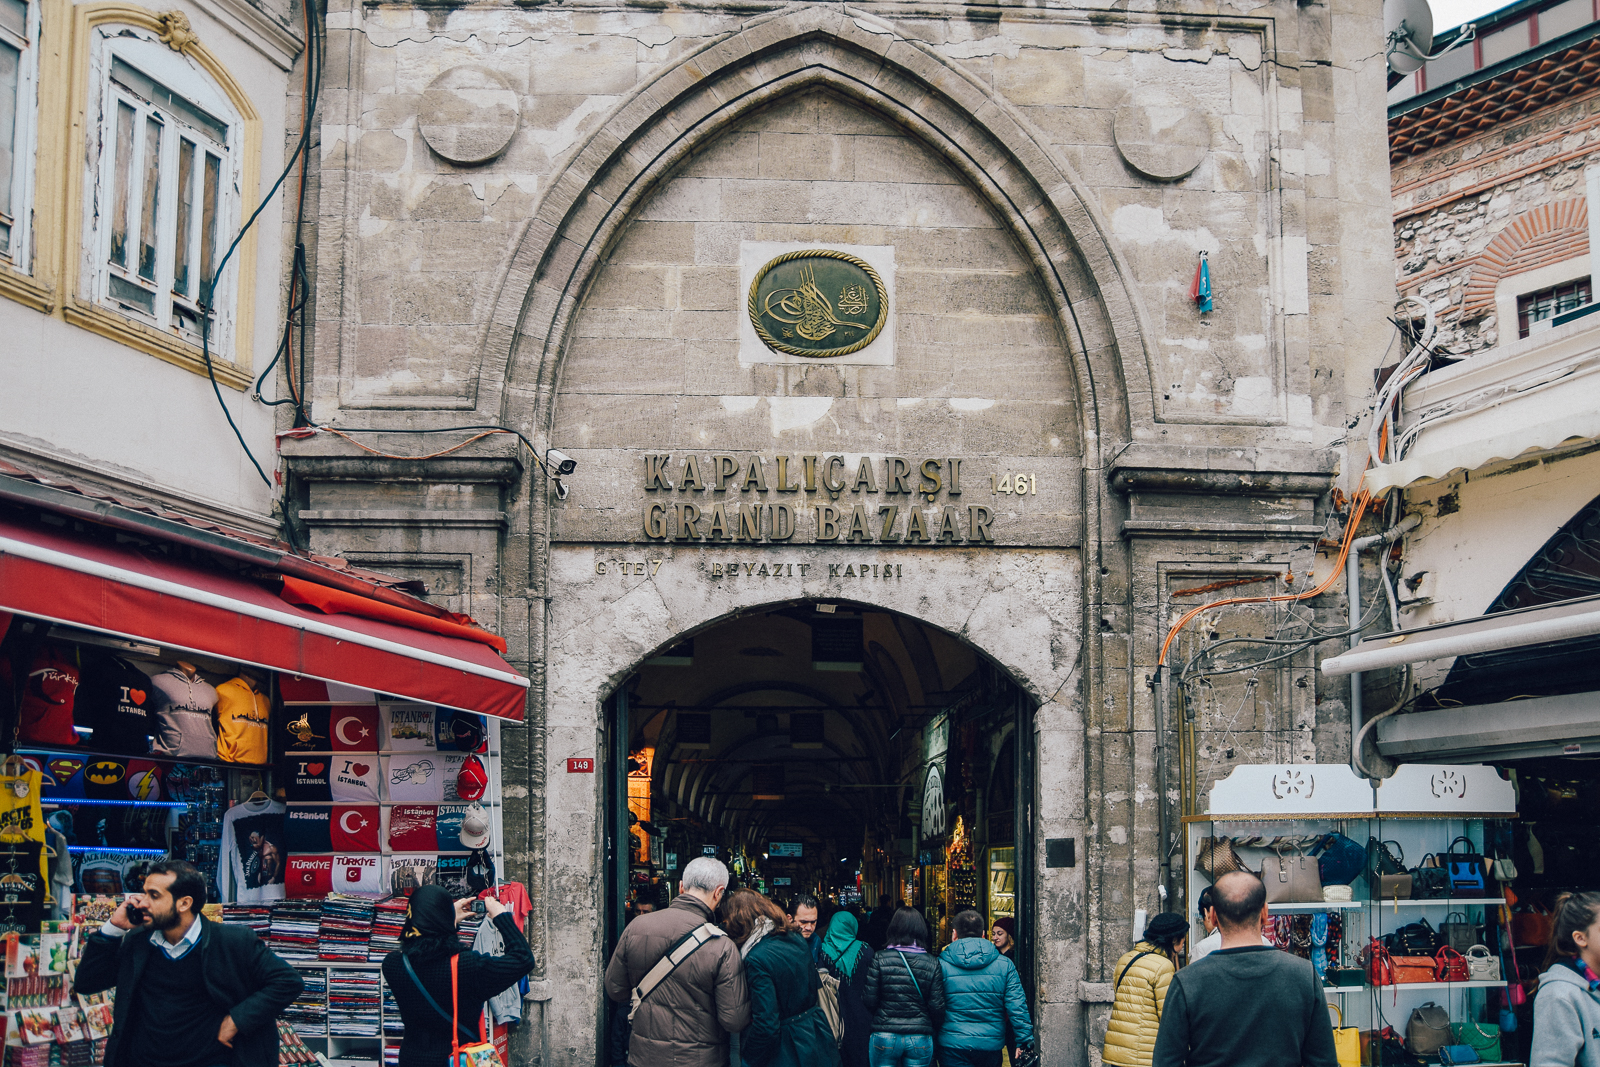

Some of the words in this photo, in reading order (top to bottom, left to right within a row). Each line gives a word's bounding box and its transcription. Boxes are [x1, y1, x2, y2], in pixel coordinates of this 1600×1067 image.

[645, 453, 962, 502] KAPALIÇARŞI
[990, 473, 1037, 496] 1461
[644, 502, 795, 540] GRAND
[816, 504, 995, 542] BAZAAR
[652, 559, 663, 576] 7
[712, 562, 810, 578] BEYAZIT
[828, 563, 903, 578] KAPISI
[120, 686, 130, 703] I
[297, 762, 308, 776] I
[341, 760, 353, 774] I
[573, 761, 588, 770] 149
[437, 857, 470, 868] istan
